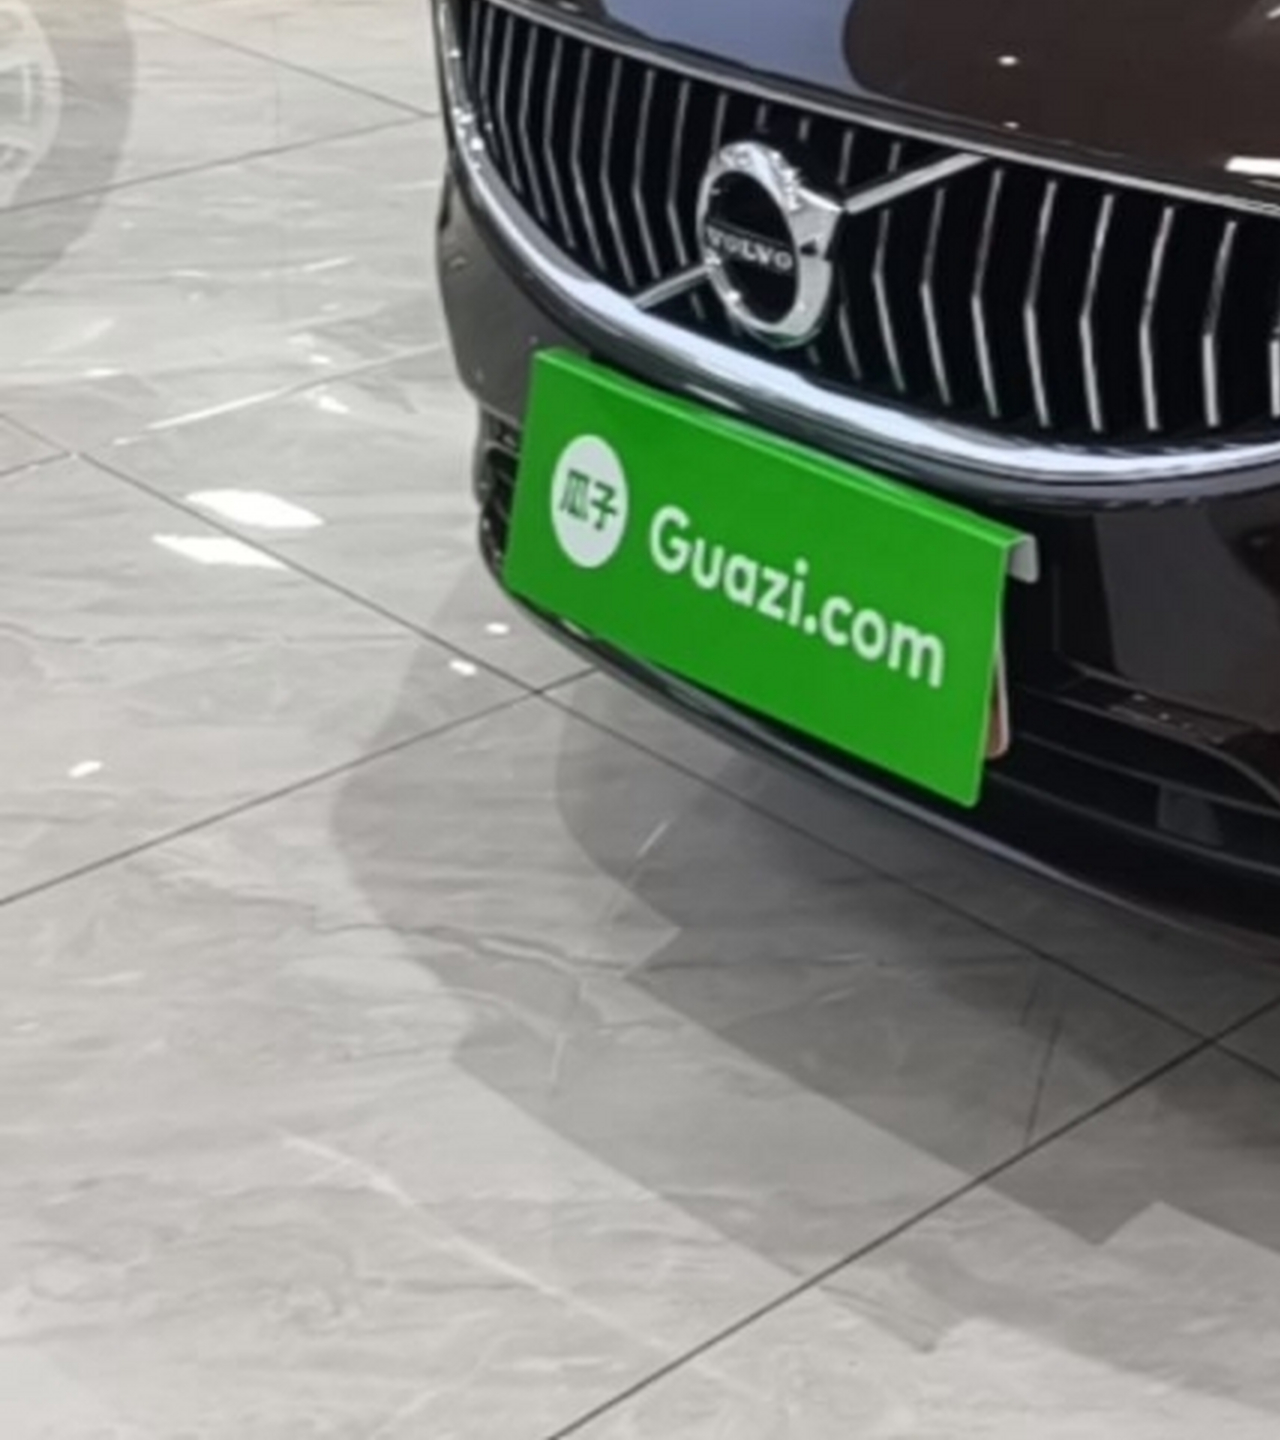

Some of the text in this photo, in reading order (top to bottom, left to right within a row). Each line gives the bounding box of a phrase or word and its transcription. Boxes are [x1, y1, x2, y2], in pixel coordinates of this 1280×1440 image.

[707, 224, 793, 271] VOLVO
[559, 467, 618, 531] 瓜子
[650, 505, 945, 688] Guazi.com
